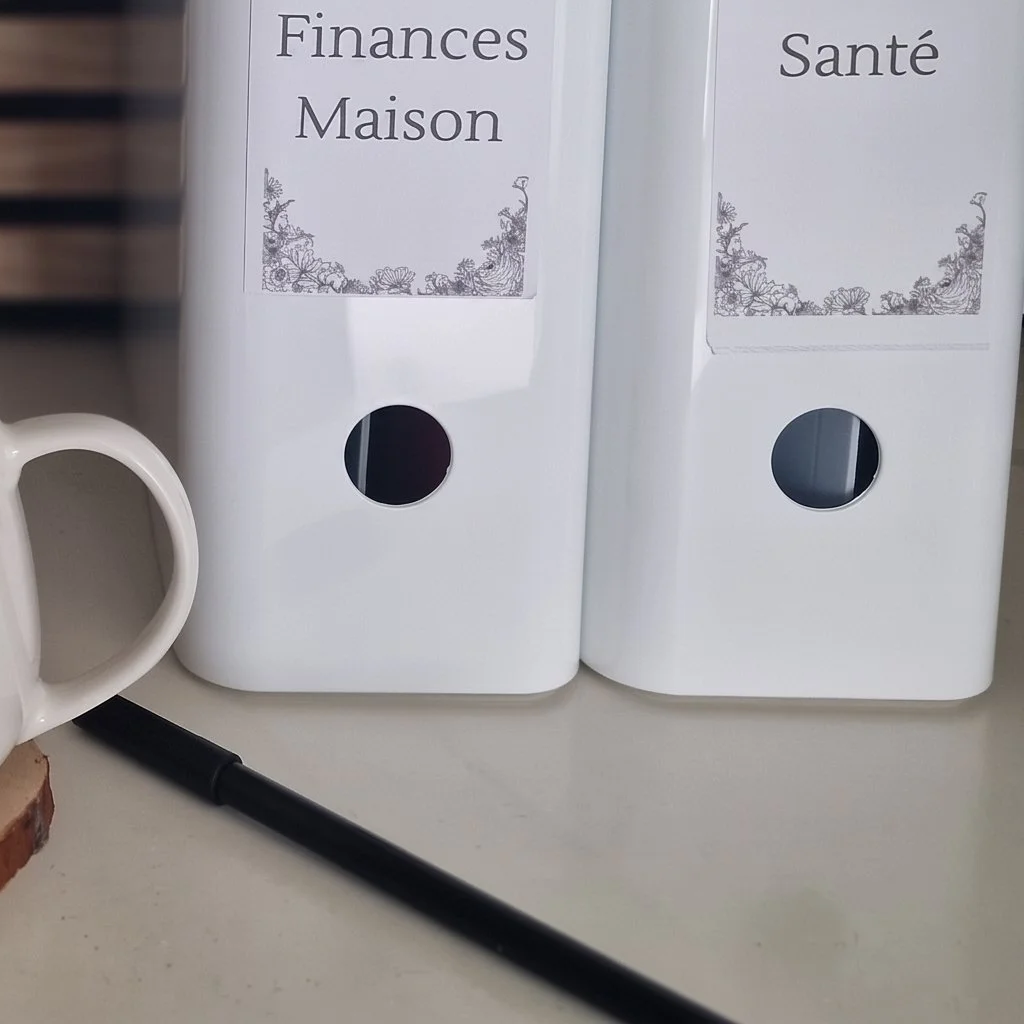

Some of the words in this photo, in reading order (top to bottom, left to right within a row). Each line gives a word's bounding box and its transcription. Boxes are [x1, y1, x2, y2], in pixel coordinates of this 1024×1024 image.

[276, 12, 528, 61] Finances
[779, 29, 939, 77] Santé
[294, 95, 503, 142] Maison
